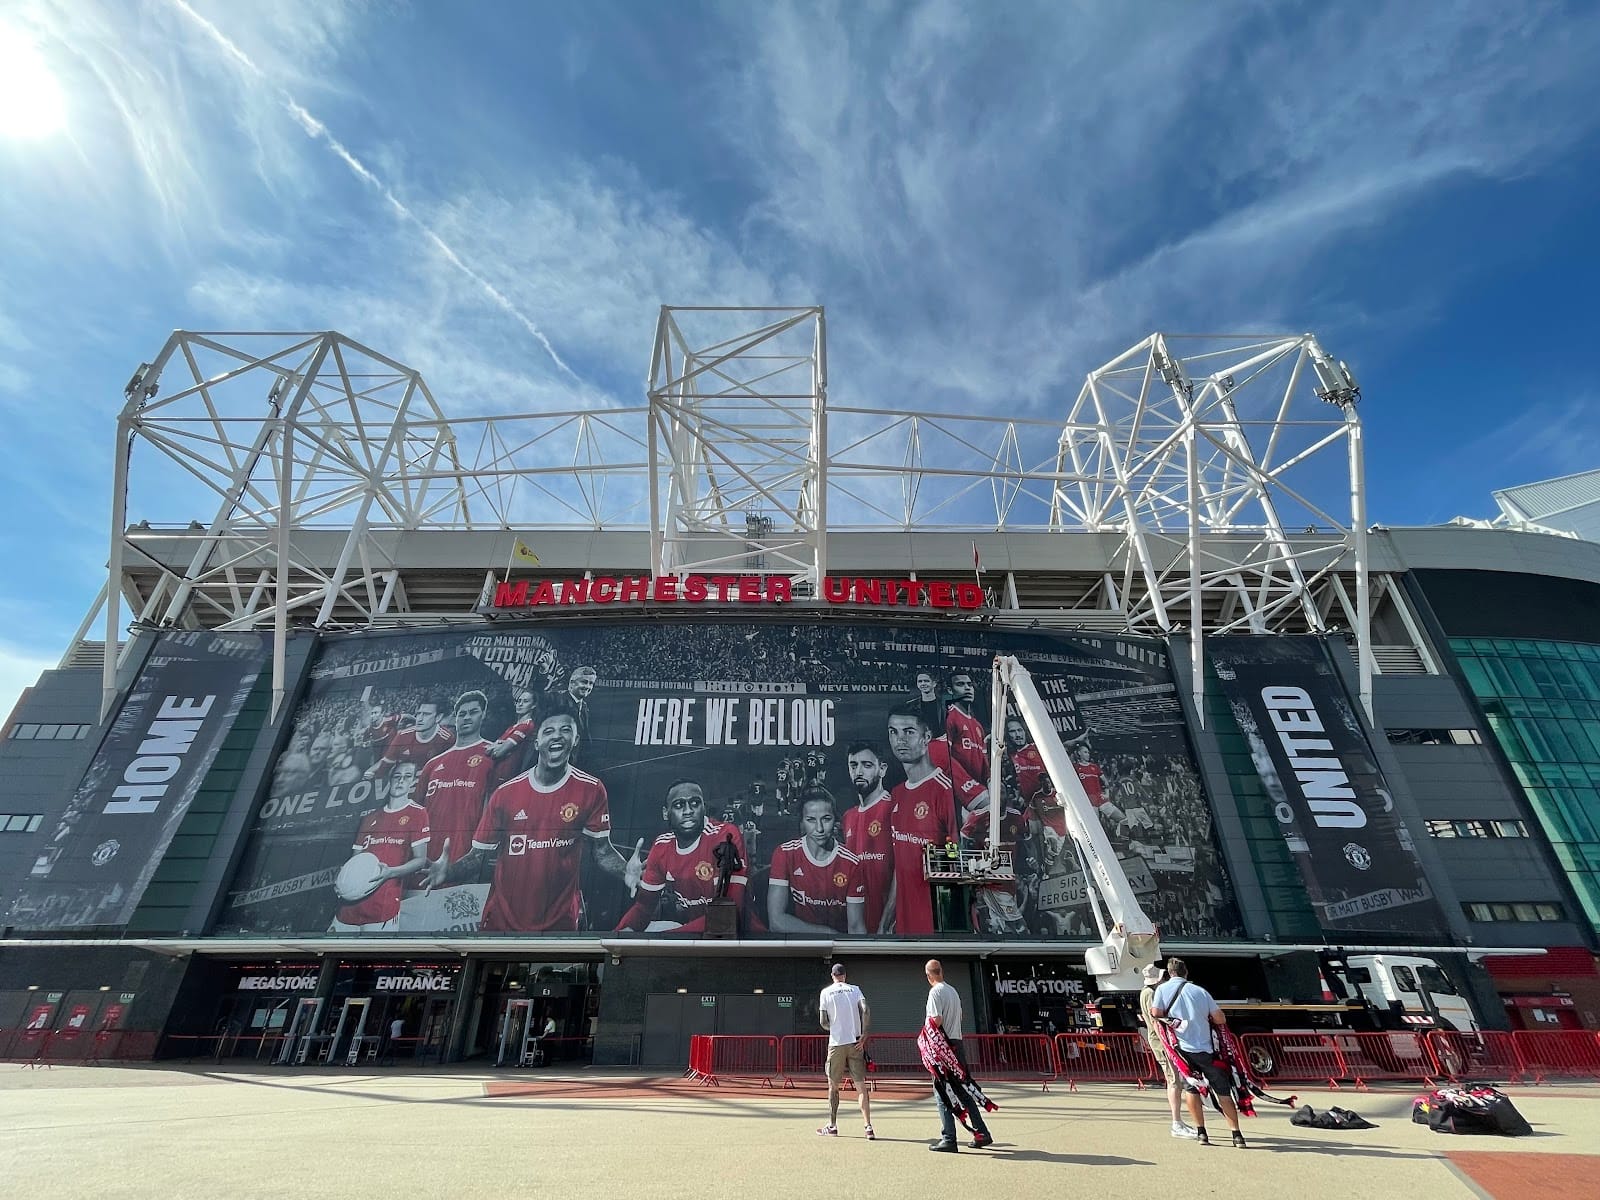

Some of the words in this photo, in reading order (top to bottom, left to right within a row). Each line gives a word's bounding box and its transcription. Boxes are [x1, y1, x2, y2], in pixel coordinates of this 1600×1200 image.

[494, 576, 793, 607] MANCHESTER
[823, 576, 986, 609] UNITED
[484, 648, 514, 662] UTD
[1115, 641, 1170, 669] UNITE
[661, 681, 692, 689] FOOTBALL
[851, 684, 876, 692] WON
[878, 684, 889, 692] IT
[890, 684, 910, 692] ALL
[1041, 679, 1069, 695] THE
[634, 698, 696, 746] HERE
[705, 698, 738, 745] WE
[749, 698, 835, 747] BELONG
[103, 694, 217, 814] HOME
[1260, 686, 1367, 829] UNITED
[1122, 782, 1135, 796] 10
[259, 791, 320, 819] ONE
[271, 879, 306, 896] BUSBY
[1060, 876, 1078, 888] SIR
[1127, 874, 1147, 889] AY
[1339, 900, 1360, 915] MATT
[1361, 891, 1393, 911] BUSBY
[238, 976, 319, 990] MEGASTORE
[375, 976, 452, 991] ENTRANCE
[994, 979, 1085, 994] MEGASTORE
